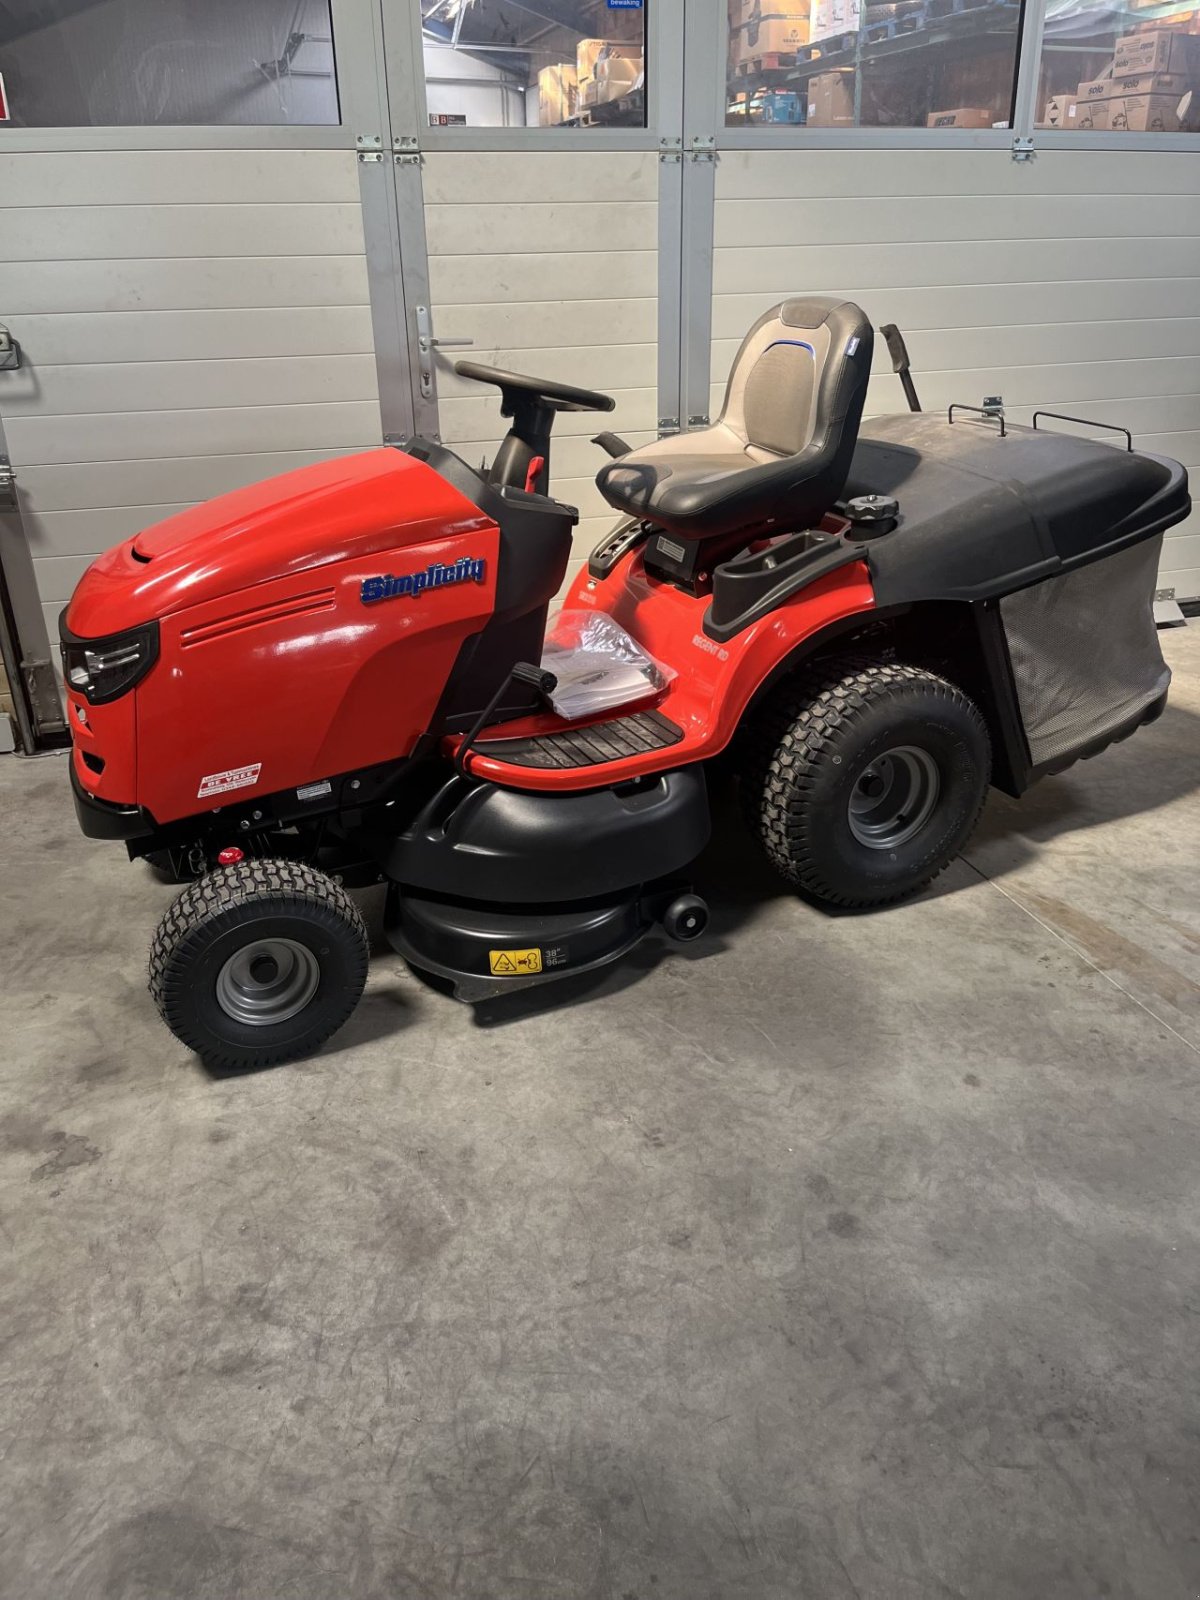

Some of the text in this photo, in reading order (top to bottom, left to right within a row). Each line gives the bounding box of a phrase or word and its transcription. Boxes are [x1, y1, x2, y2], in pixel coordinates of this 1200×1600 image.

[1088, 84, 1104, 95] solo
[1122, 78, 1139, 90] solo
[360, 557, 486, 603] Simplicity
[207, 779, 221, 787] DE
